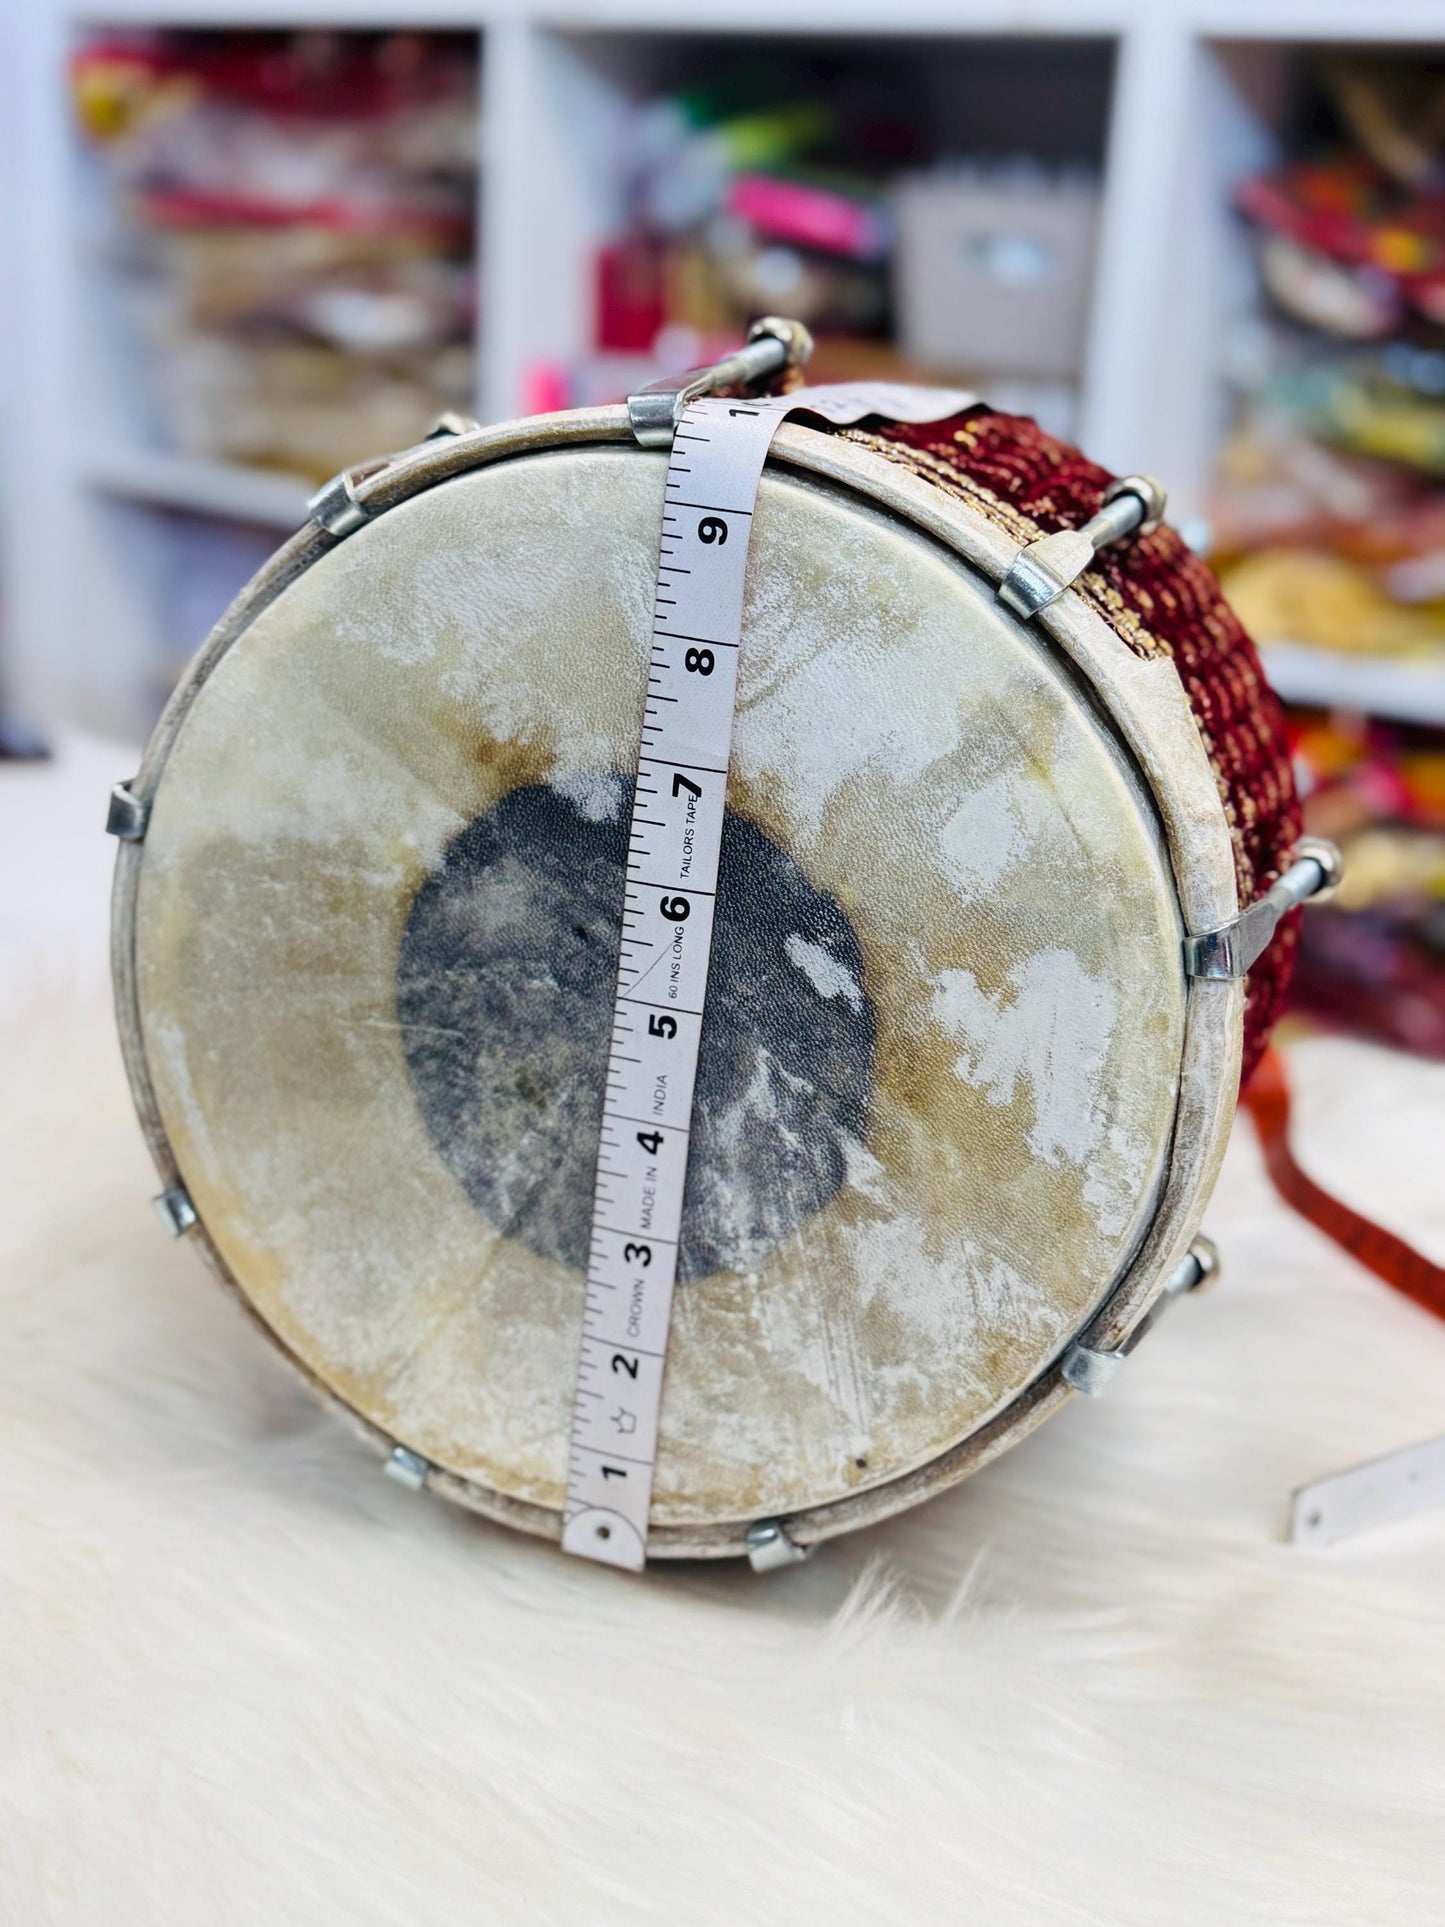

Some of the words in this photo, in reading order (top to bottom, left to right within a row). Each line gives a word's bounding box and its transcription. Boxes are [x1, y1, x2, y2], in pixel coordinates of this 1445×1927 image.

[698, 516, 729, 546] 9
[684, 647, 715, 676] 8
[671, 772, 702, 799] 7
[685, 794, 698, 826] TAPE
[680, 827, 695, 880] TAILORS
[659, 895, 691, 922] 6
[672, 925, 685, 960] LONG
[670, 962, 681, 983] INS
[668, 985, 678, 999] 60
[647, 1013, 678, 1040] 5
[652, 1074, 668, 1117] INDIA
[636, 1130, 664, 1156] 4
[645, 1166, 657, 1182] IN
[640, 1186, 656, 1230] MADE
[623, 1242, 652, 1268] 3
[627, 1278, 645, 1338] CROWN
[611, 1354, 639, 1380] 2
[601, 1465, 627, 1480] 1
